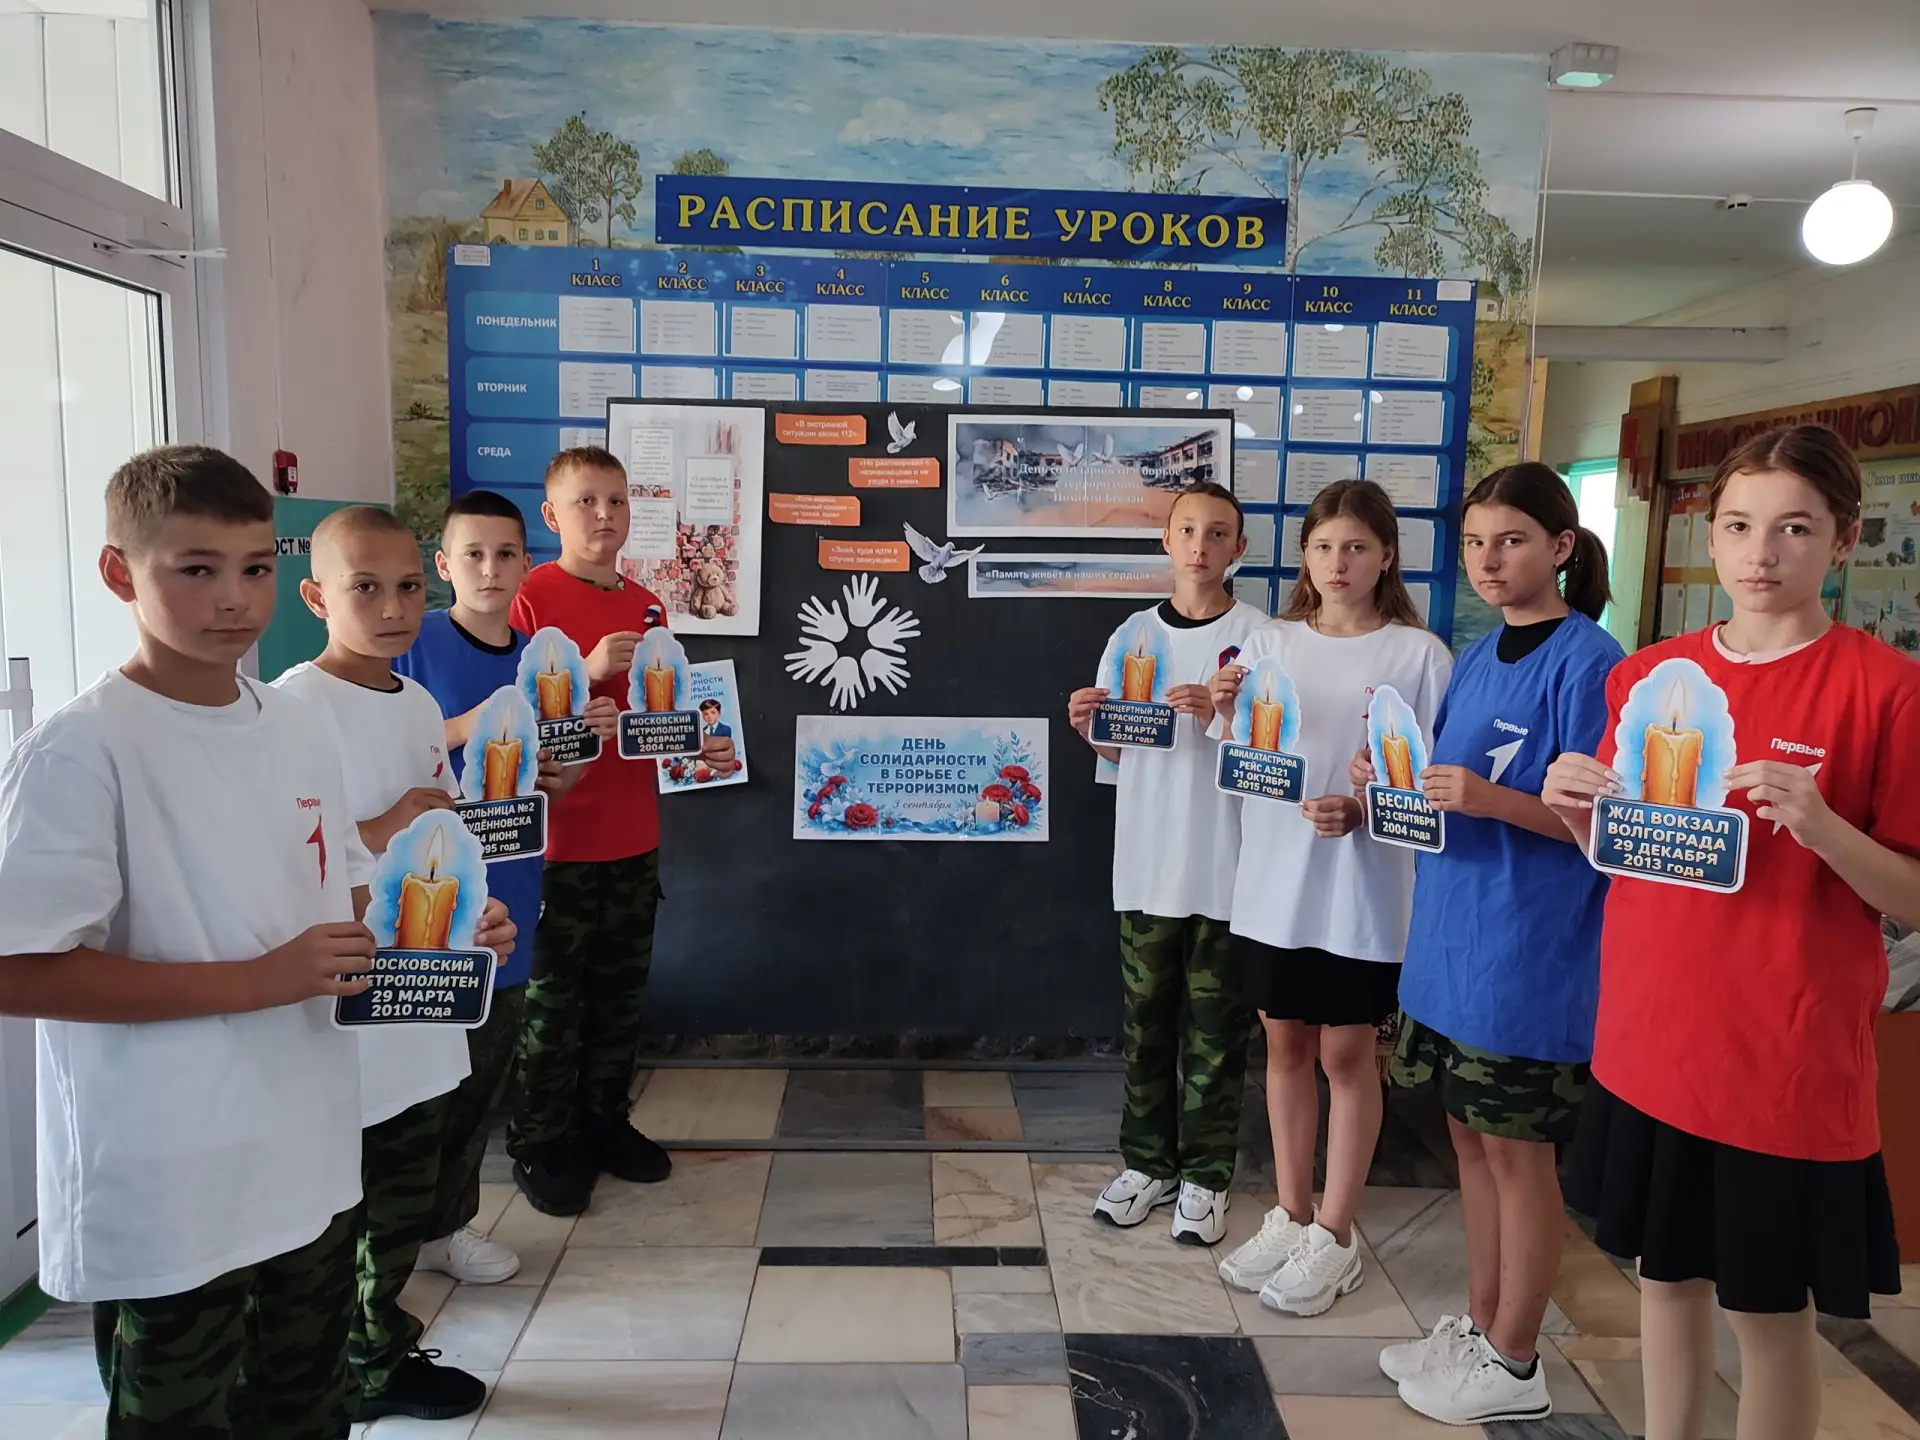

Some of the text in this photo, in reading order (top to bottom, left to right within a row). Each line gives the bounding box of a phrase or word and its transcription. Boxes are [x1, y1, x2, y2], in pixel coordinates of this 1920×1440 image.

[678, 194, 1265, 249] РАСПИСАНИЕ УРОКОВ
[592, 258, 600, 271] 1
[677, 262, 688, 274] 2
[755, 264, 765, 277] 3
[571, 274, 622, 288] КЛАСС
[835, 268, 846, 280] 4
[921, 272, 930, 284] 5
[1000, 274, 1010, 287] 6
[657, 276, 709, 291] КЛАСС
[735, 279, 785, 294] КЛАСС
[816, 282, 866, 296] КЛАСС
[1083, 276, 1092, 289] 7
[1163, 279, 1173, 293] 8
[1243, 282, 1252, 295] 9
[901, 286, 950, 300] КЛАСС
[980, 288, 1030, 303] КЛАСС
[1062, 291, 1112, 306] КЛАСС
[1322, 285, 1339, 298] 10
[1406, 288, 1422, 301] 11
[1143, 293, 1192, 308] КЛАСС
[1222, 296, 1271, 311] КЛАСС
[1304, 300, 1354, 314] КЛАСС
[1389, 303, 1438, 317] КЛАСС
[476, 315, 557, 328] ПОНЕДЕЛЬНИК
[476, 382, 527, 394] ВТОРНИК
[477, 446, 512, 458] СРЕДА
[1141, 465, 1181, 479] борьбе
[275, 538, 295, 555] ОСТ
[985, 569, 1029, 580] «Память
[1073, 571, 1106, 579] наших
[691, 676, 724, 686] РНОСТИ
[690, 685, 712, 693] РЬБЕ
[690, 691, 724, 700] РИЗМОМ
[1100, 703, 1171, 717] КОНЦЕРТНЫЙ ЗАЛ
[629, 713, 691, 726] МОСКОВСКИЙ
[1101, 712, 1169, 726] В КРАСНОГОРСКЕ
[540, 719, 586, 738] ЕТРО
[627, 725, 695, 736] МЕТРОПОЛИТЕН
[1108, 723, 1158, 736] 22 МАРТА
[1492, 717, 1529, 736] Первые
[637, 734, 686, 744] 6 ФЕВРАЛЯ
[901, 738, 947, 751] ДЕНЬ
[1110, 732, 1155, 744] 2024 года
[548, 741, 580, 753] ПРЕЛЯ
[639, 743, 685, 753] 2004 года
[1769, 737, 1826, 758] Первые
[557, 751, 580, 760] года
[860, 753, 987, 767] СОЛИДАРНОСТИ
[1228, 747, 1298, 768] АВИАКАТАСТРОФА
[880, 769, 967, 780] В БОРЬБЕ С
[1239, 760, 1288, 778] РЕЙС А321
[1232, 769, 1291, 788] 31 ОКТЯБРЯ
[867, 782, 979, 795] ТЕРРОРИЗМОМ
[1236, 779, 1284, 796] 2015 года
[892, 799, 952, 812] 3 сентября
[1376, 791, 1433, 814] БЕСЛАН
[460, 801, 535, 820] БОЛЬНИЦА №2
[466, 815, 532, 833] УДЁННОВСКА
[1392, 811, 1436, 828] СЕНТЯБРЯ
[1607, 804, 1730, 835] Ж/Д ВОКЗАЛ
[488, 829, 518, 842] ИЮНЯ
[1382, 821, 1431, 841] 2004 года
[1607, 821, 1727, 852] ВОЛГОГРАДА
[482, 842, 520, 854] 95 года
[1613, 838, 1718, 866] 29 ДЕКАБРЯ
[1623, 853, 1704, 878] 2013 года
[371, 989, 456, 1003] 29 МАРТА
[371, 1004, 452, 1018] 2010 года
